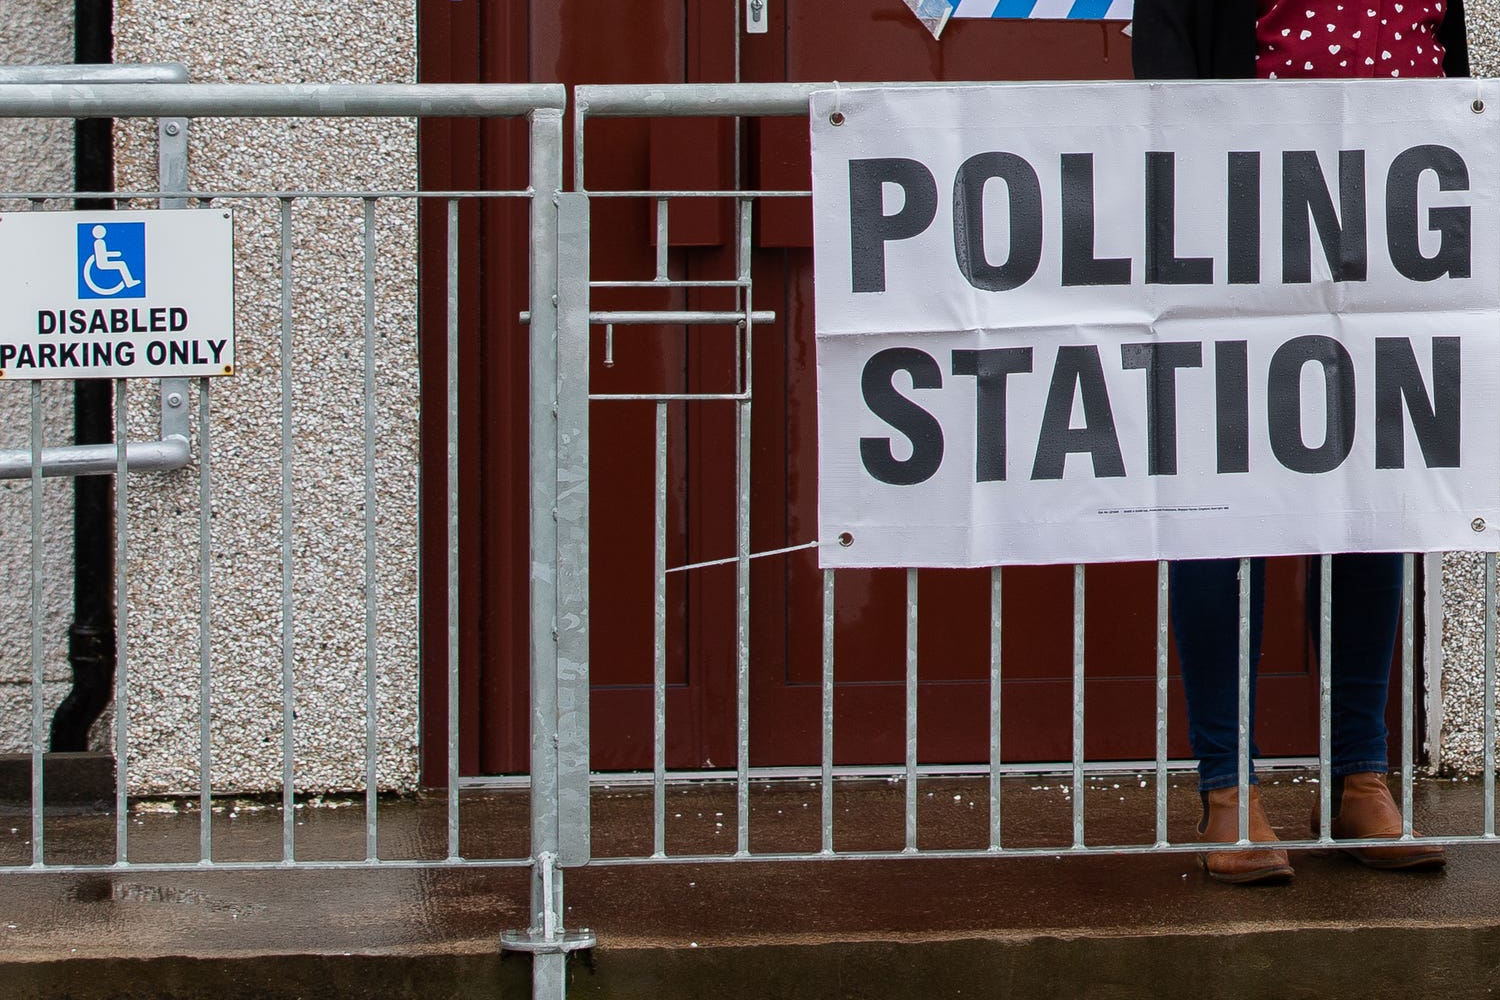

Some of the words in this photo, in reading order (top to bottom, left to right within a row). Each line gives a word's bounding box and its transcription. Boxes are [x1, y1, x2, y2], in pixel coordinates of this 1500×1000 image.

[849, 144, 1472, 293] POLLING
[0, 341, 136, 369] PARKING
[146, 339, 228, 366] ONLY
[38, 307, 188, 334] DISABLED
[859, 334, 1461, 486] STATION
